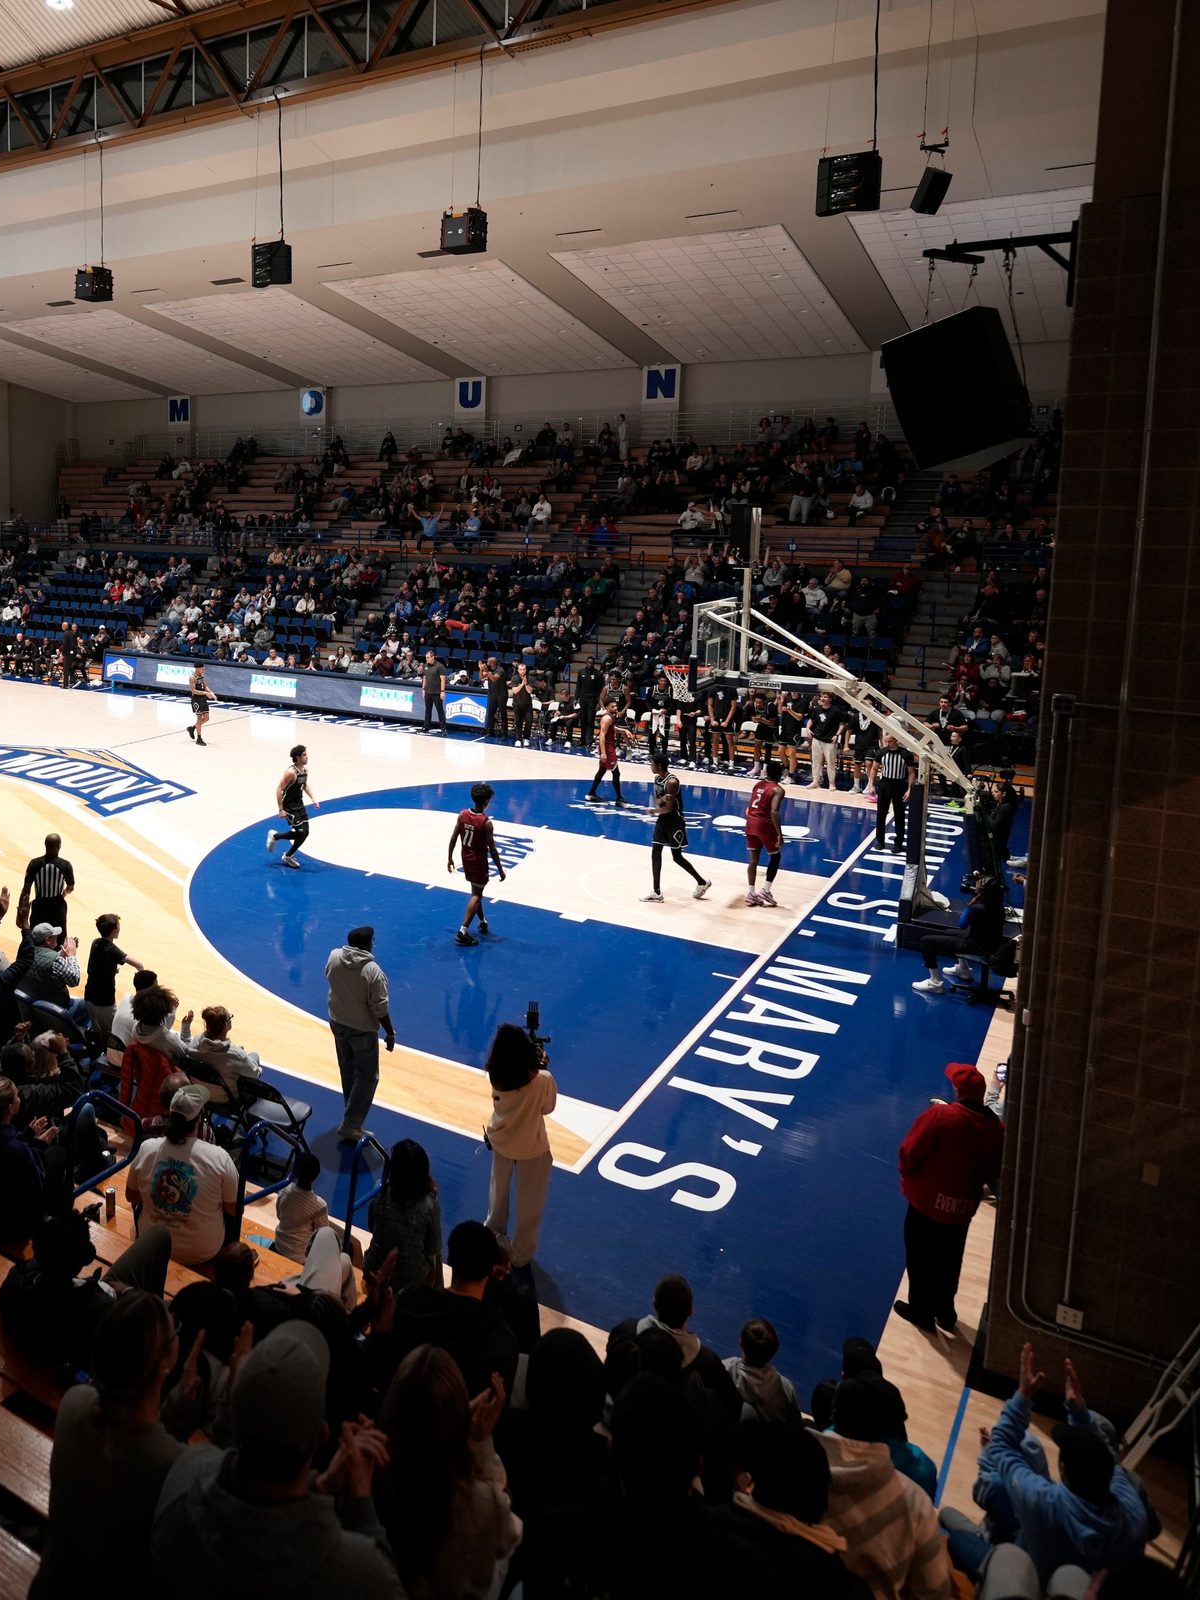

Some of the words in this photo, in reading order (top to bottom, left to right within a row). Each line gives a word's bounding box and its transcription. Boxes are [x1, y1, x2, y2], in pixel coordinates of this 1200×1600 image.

[169, 398, 189, 423] M
[302, 391, 323, 416] O
[458, 381, 482, 409] U
[646, 369, 676, 400] N
[446, 704, 461, 718] THE
[461, 704, 486, 722] MOUNT
[752, 793, 762, 809] 2
[462, 829, 474, 847] 11
[798, 891, 900, 942] ST.
[597, 955, 872, 1213] MARY'S
